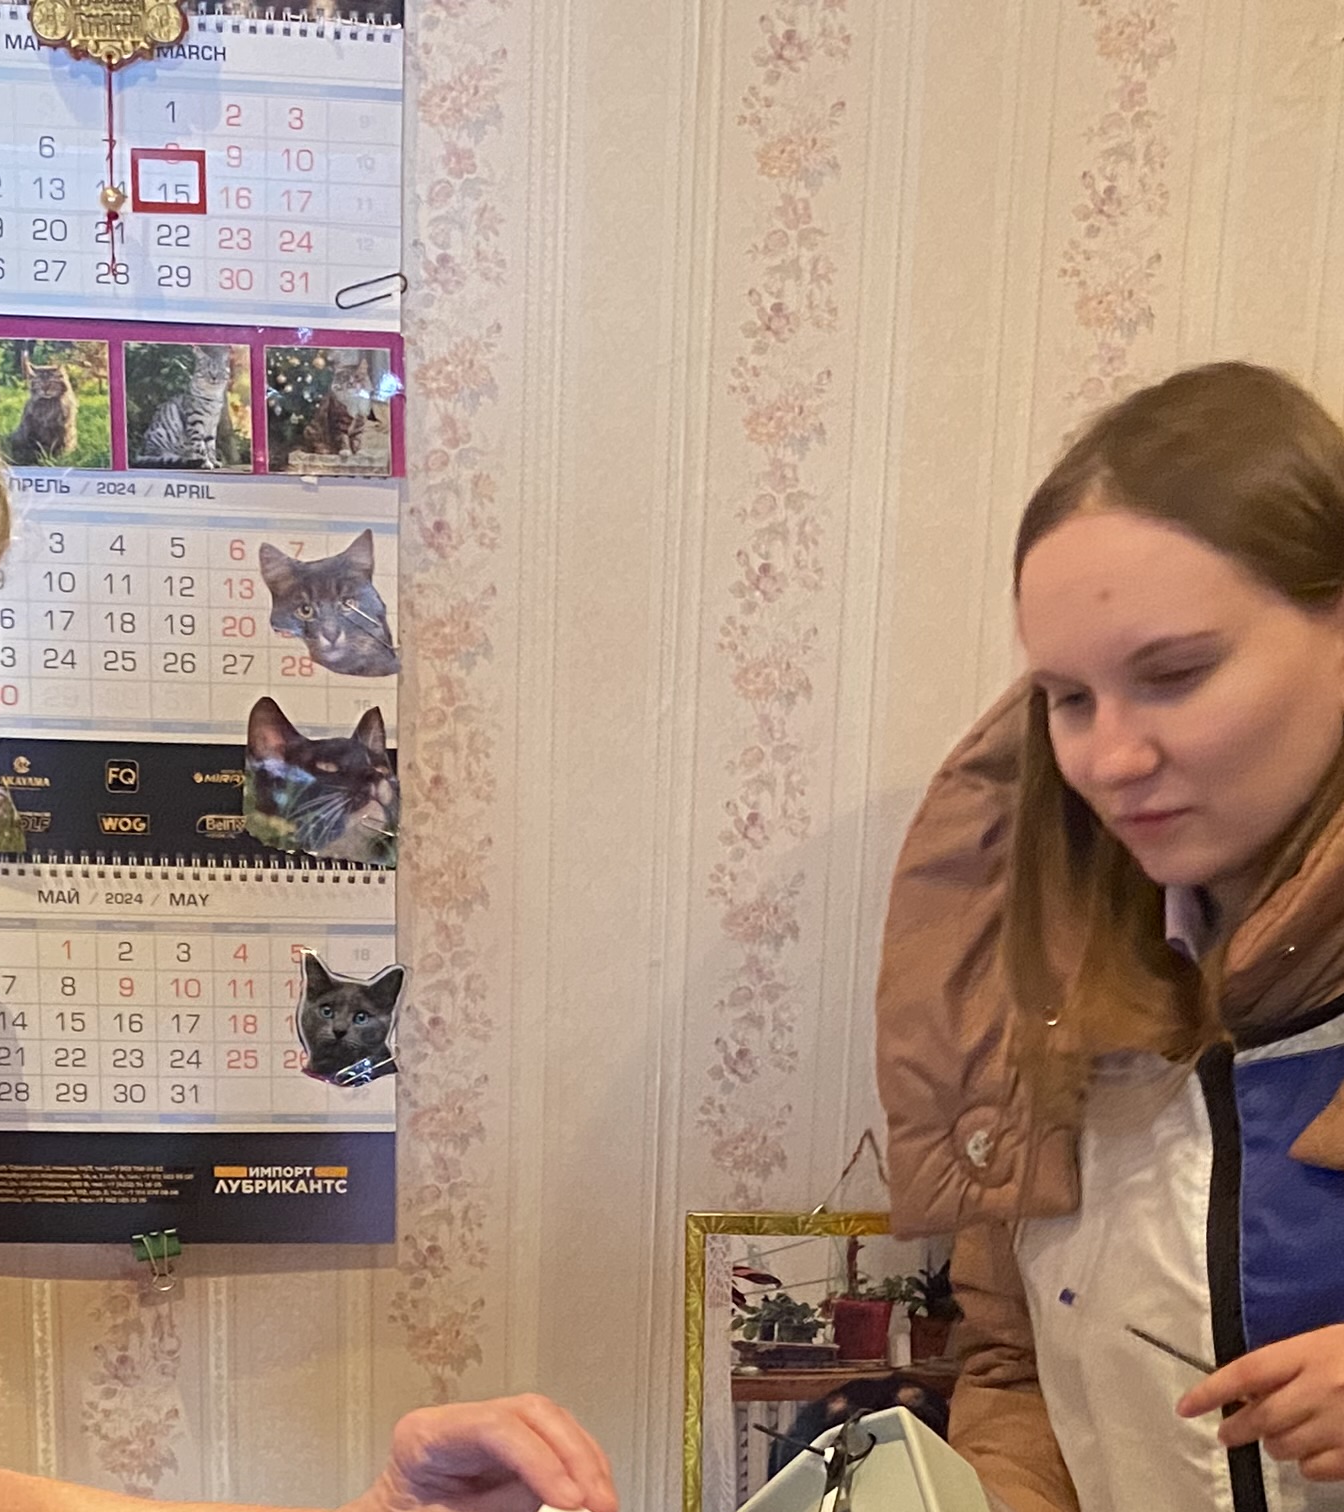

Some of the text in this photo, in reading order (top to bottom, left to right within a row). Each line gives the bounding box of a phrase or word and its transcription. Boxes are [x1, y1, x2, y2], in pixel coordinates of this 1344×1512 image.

[157, 45, 226, 62] MARCH
[166, 101, 175, 123] 1
[225, 105, 242, 127] 2
[288, 108, 304, 130] 3
[39, 136, 55, 158] 6
[226, 146, 242, 168] 9
[281, 150, 314, 172] 10
[33, 178, 66, 200] 13
[158, 183, 190, 203] 15
[219, 188, 252, 210] 16
[281, 191, 312, 213] 17
[32, 219, 68, 242] 20
[95, 221, 124, 244] 21
[157, 224, 190, 247] 22
[218, 228, 252, 251] 23
[279, 231, 313, 253] 24
[33, 260, 67, 282] 27
[96, 262, 129, 285] 28
[158, 265, 191, 288] 29
[219, 268, 253, 291] 30
[280, 270, 310, 293] 31
[9, 478, 70, 494] ПРЕЛЬ
[97, 482, 136, 495] 2024
[164, 484, 216, 499] APRIL
[49, 532, 304, 561] 3 4 5 6 7
[43, 571, 76, 593] 10
[104, 573, 132, 595] 11
[164, 576, 195, 597] 12
[224, 578, 254, 600] 13
[0, 608, 256, 638] 6 17 18 19 20
[43, 648, 77, 669] 24
[104, 650, 137, 672] 25
[163, 652, 196, 673] 26
[222, 654, 255, 675] 27
[281, 656, 314, 677] 28
[108, 768, 136, 785] FQ
[102, 817, 146, 832] WOG
[38, 888, 80, 905] МАЙ
[105, 893, 143, 905] 2024
[169, 893, 209, 907] MAY
[62, 940, 72, 960] 1
[118, 941, 134, 962] 2
[176, 942, 191, 963] 3
[233, 944, 248, 963] 4
[2, 975, 17, 995] 7
[60, 976, 76, 996] 8
[119, 977, 134, 997] 9
[170, 978, 201, 998] 10
[228, 979, 254, 999] 11
[56, 1012, 86, 1032] 15
[113, 1013, 143, 1033] 16
[171, 1013, 201, 1034] 17
[228, 1014, 258, 1034] 18
[55, 1048, 87, 1068] 22
[112, 1048, 144, 1069] 23
[169, 1049, 202, 1069] 24
[227, 1050, 258, 1070] 25
[56, 1083, 88, 1103] 29
[113, 1083, 146, 1104] 30
[170, 1084, 199, 1104] 31
[249, 1166, 313, 1178] ИМПОРТ
[214, 1179, 348, 1194] ЛУБРИКАНТС
